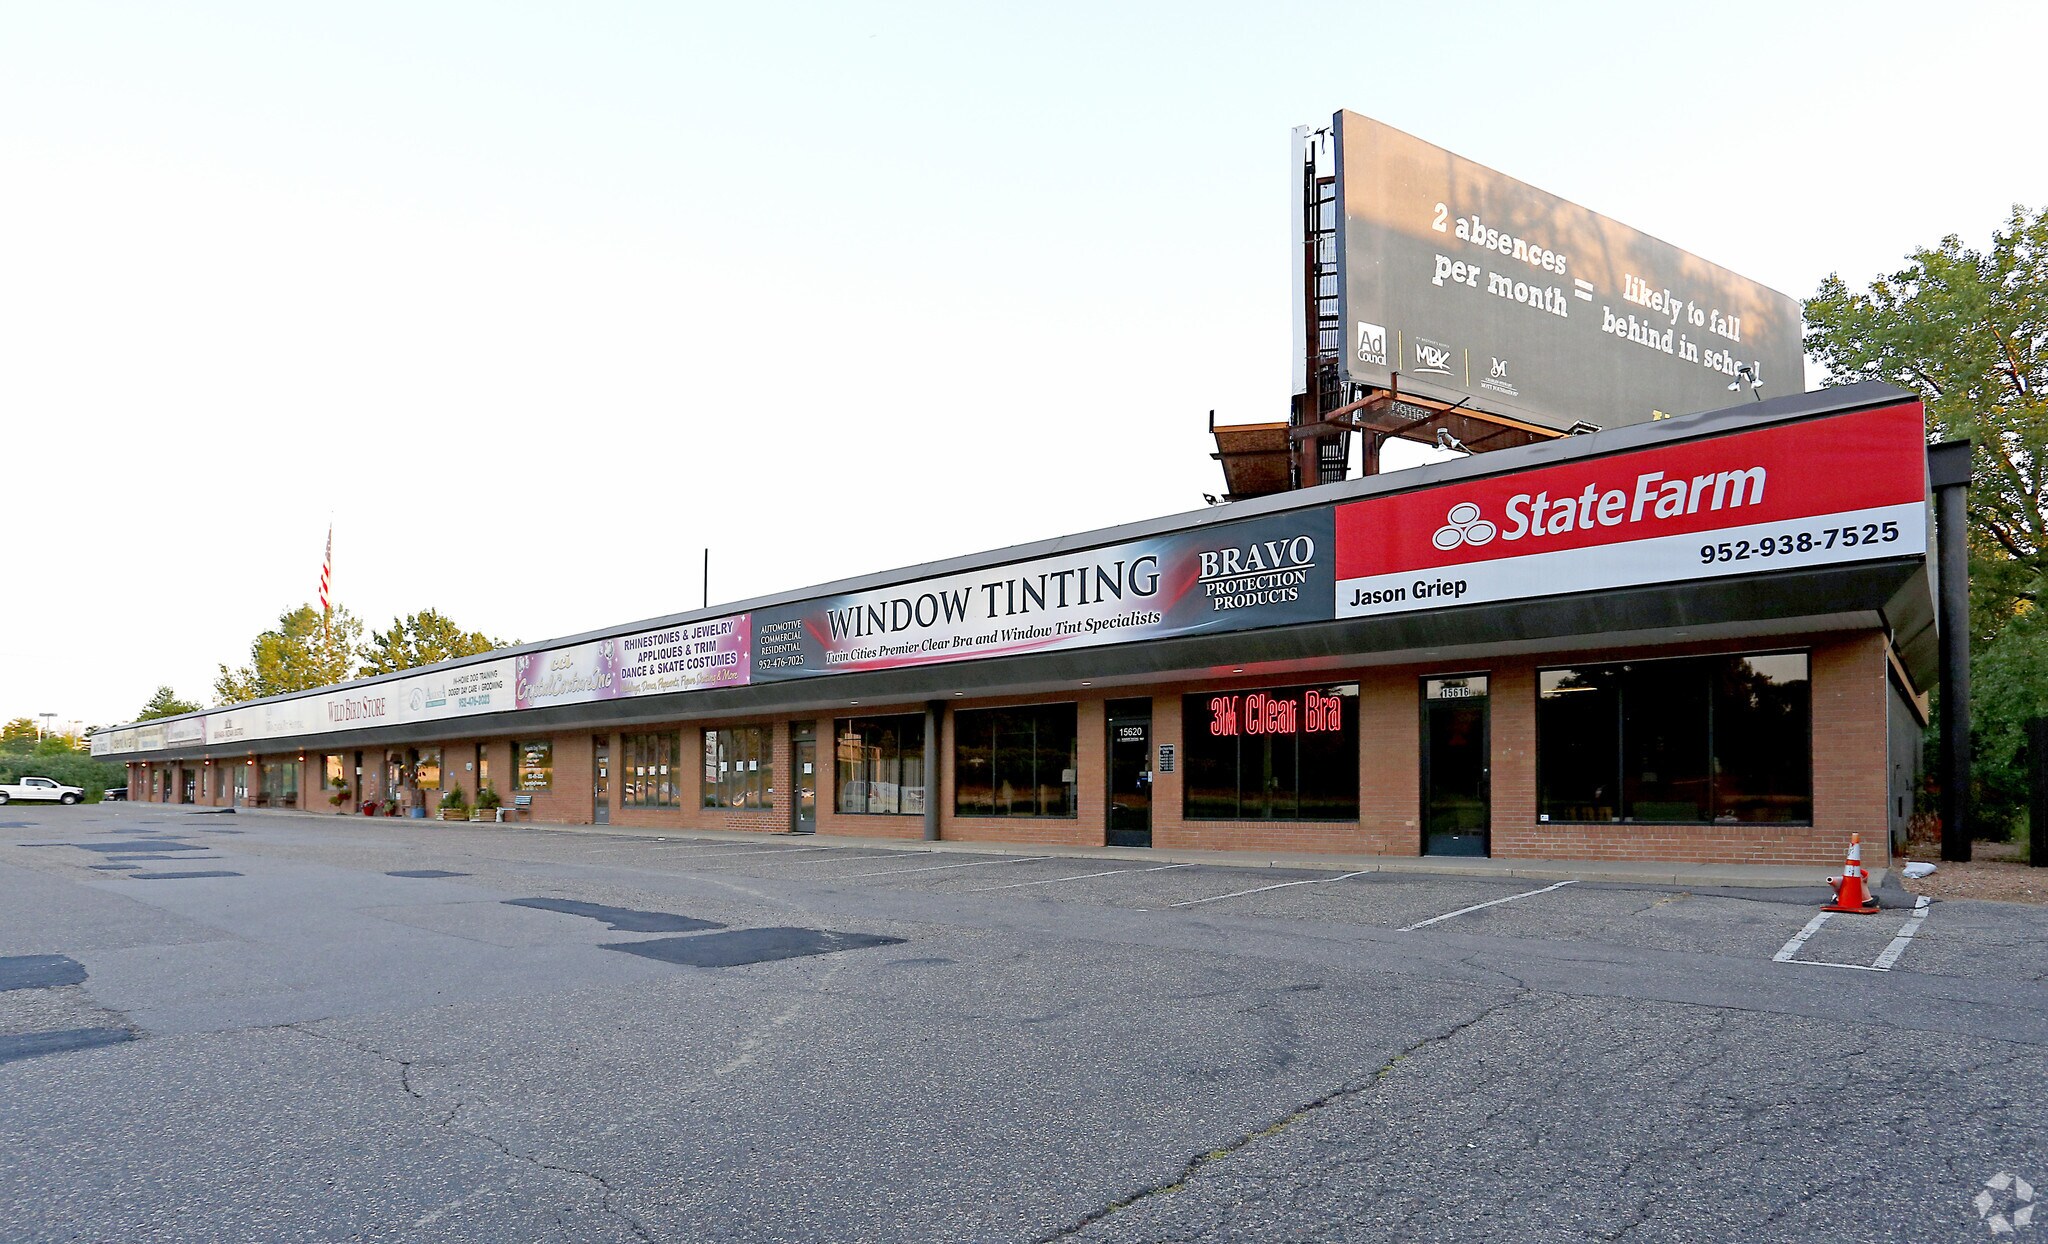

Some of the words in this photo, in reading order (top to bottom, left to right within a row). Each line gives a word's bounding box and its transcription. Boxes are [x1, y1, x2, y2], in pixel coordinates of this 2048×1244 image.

[1432, 202, 1448, 233] 2
[1455, 215, 1567, 275] absences
[1432, 254, 1481, 287] per
[1487, 272, 1568, 318] month
[1623, 273, 1682, 325] likely
[1687, 301, 1705, 327] to
[1709, 308, 1741, 343] fall
[1359, 330, 1382, 355] Ad
[1602, 306, 1674, 355] behind
[1678, 333, 1699, 363] in
[1358, 349, 1387, 366] Council
[1700, 521, 1899, 564] 952-938-7525
[1199, 536, 1315, 579] BRAVO
[1205, 569, 1307, 597] PROTECTION
[1350, 587, 1406, 607] Jason
[1412, 578, 1467, 599] Griep
[827, 586, 973, 641] WINDOW
[981, 555, 1161, 619] TINTING
[1214, 586, 1298, 611] PRODUCTS
[624, 630, 680, 651] RHINESTONES
[682, 629, 689, 641] &
[691, 621, 733, 640] JEWELRY
[760, 619, 802, 635] AUTOMOTIVE
[760, 631, 802, 645] COMMERCIAL
[826, 651, 849, 664] Twin
[850, 647, 877, 660] Cities
[878, 641, 920, 657] Premier
[921, 637, 950, 652] Clear
[952, 635, 973, 648] Bra
[975, 629, 998, 645] and
[1001, 624, 1052, 642] Window
[1055, 620, 1082, 636] Tint
[1084, 610, 1161, 635] Specialists
[637, 645, 683, 663] APPLIQUES
[685, 644, 692, 656] &
[694, 640, 717, 655] TRIM
[758, 654, 804, 670] 952-476-7025
[761, 642, 801, 656] RESIDENTIAL
[621, 665, 647, 679] DANCE
[649, 664, 655, 675] &
[657, 660, 684, 674] SKATE
[686, 652, 737, 670] COSTUMES
[722, 668, 739, 681] More
[1442, 687, 1469, 698] 15616
[345, 698, 361, 721] BIRD
[363, 696, 386, 718] STORE
[1211, 695, 1239, 736] 3M
[1245, 694, 1297, 734] Clear
[1305, 690, 1341, 733] Bra
[1119, 727, 1143, 737] 15620
